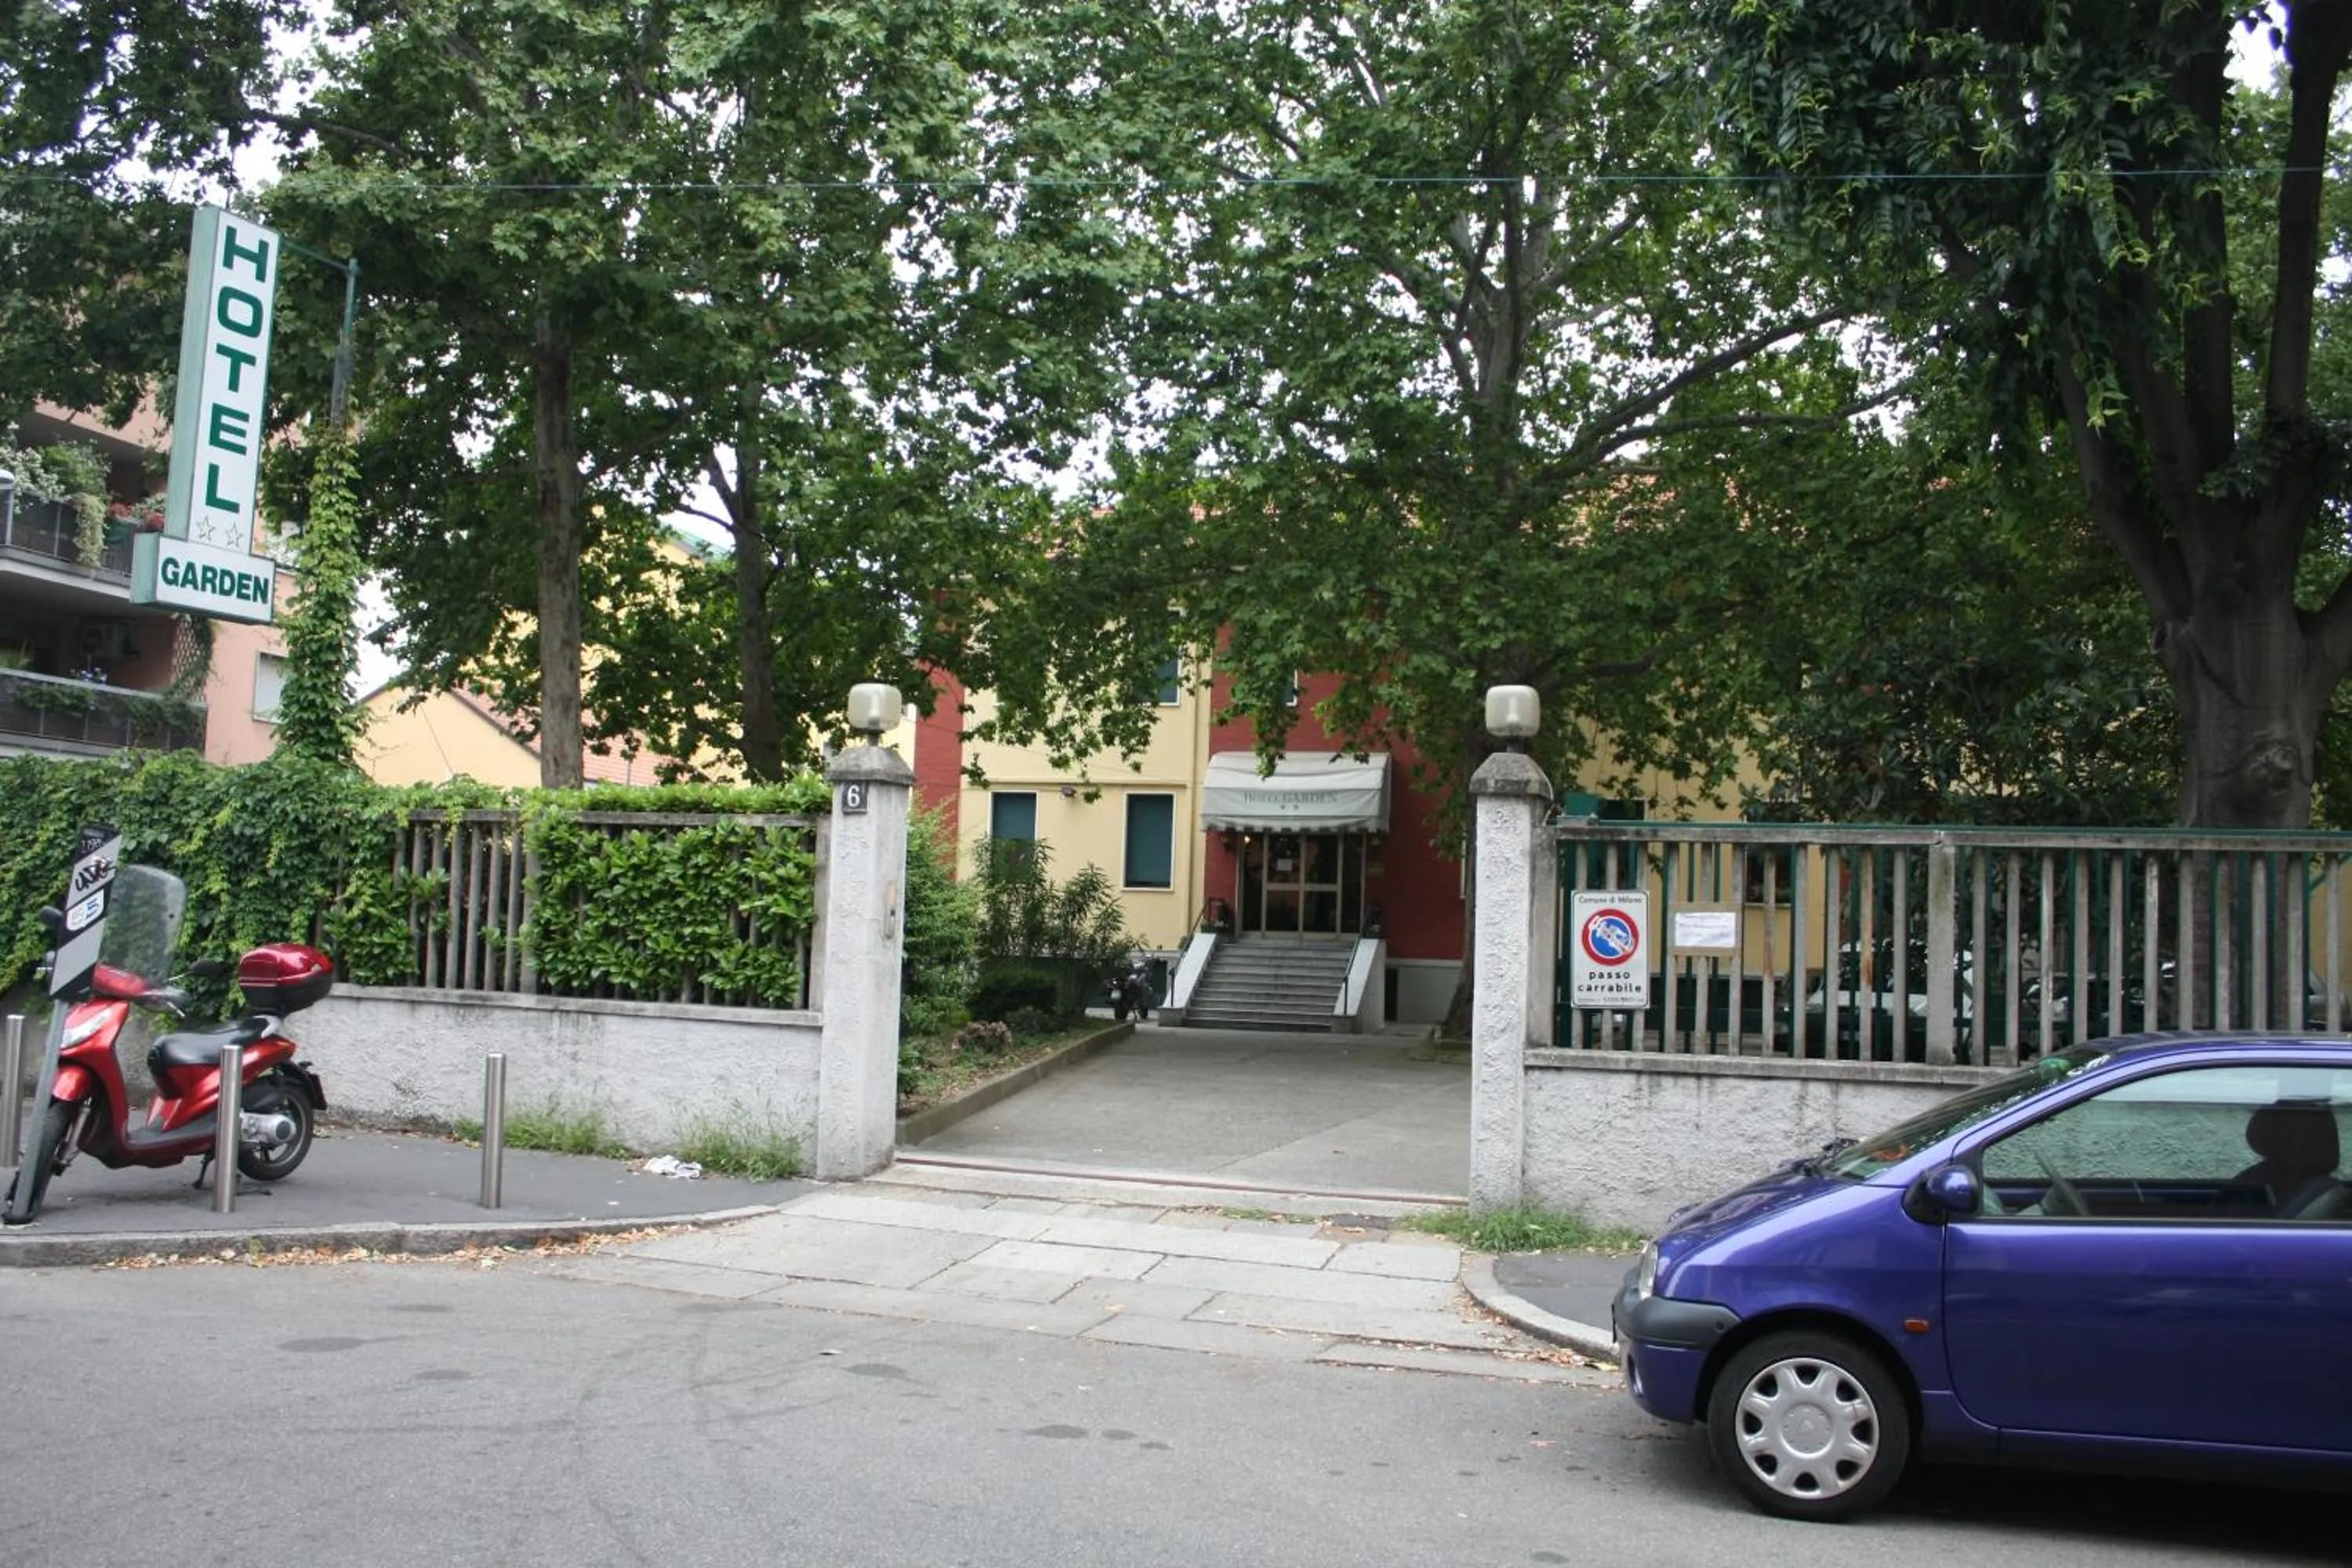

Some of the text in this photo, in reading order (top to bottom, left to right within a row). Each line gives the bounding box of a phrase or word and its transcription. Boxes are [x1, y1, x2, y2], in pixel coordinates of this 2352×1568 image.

[204, 225, 270, 514] HOTEL
[161, 557, 269, 605] GARDEN
[848, 785, 860, 808] 6
[1282, 790, 1338, 804] GARDEN
[1617, 895, 1642, 904] Milano
[1588, 971, 1631, 980] passo
[1577, 983, 1642, 993] carrabile
